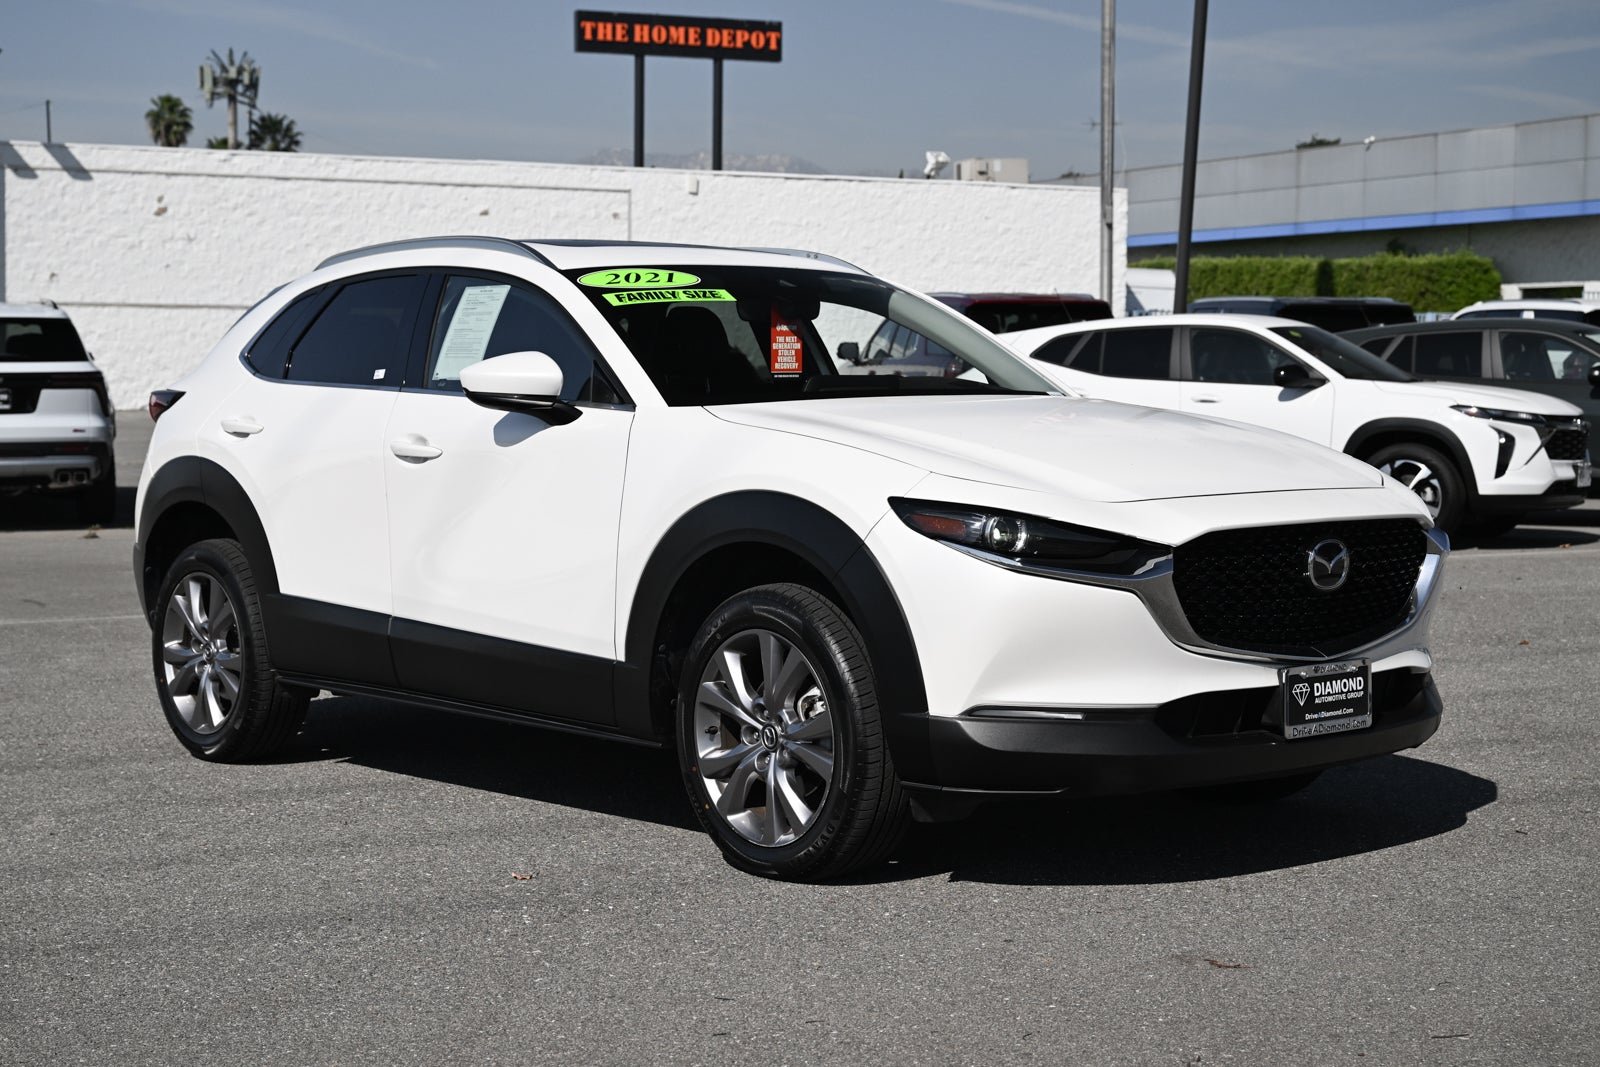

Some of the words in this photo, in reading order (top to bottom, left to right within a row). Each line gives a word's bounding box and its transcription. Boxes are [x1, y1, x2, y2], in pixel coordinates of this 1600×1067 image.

[580, 20, 629, 42] THE
[633, 23, 702, 46] HOME
[705, 27, 781, 51] DEPOT
[605, 272, 676, 284] 2021
[614, 290, 678, 302] FAMILY
[682, 289, 721, 299] SIZE
[1313, 676, 1364, 696] DIAMOND
[1314, 694, 1347, 704] AUTOMOTIVE
[1347, 690, 1364, 699] GROUP
